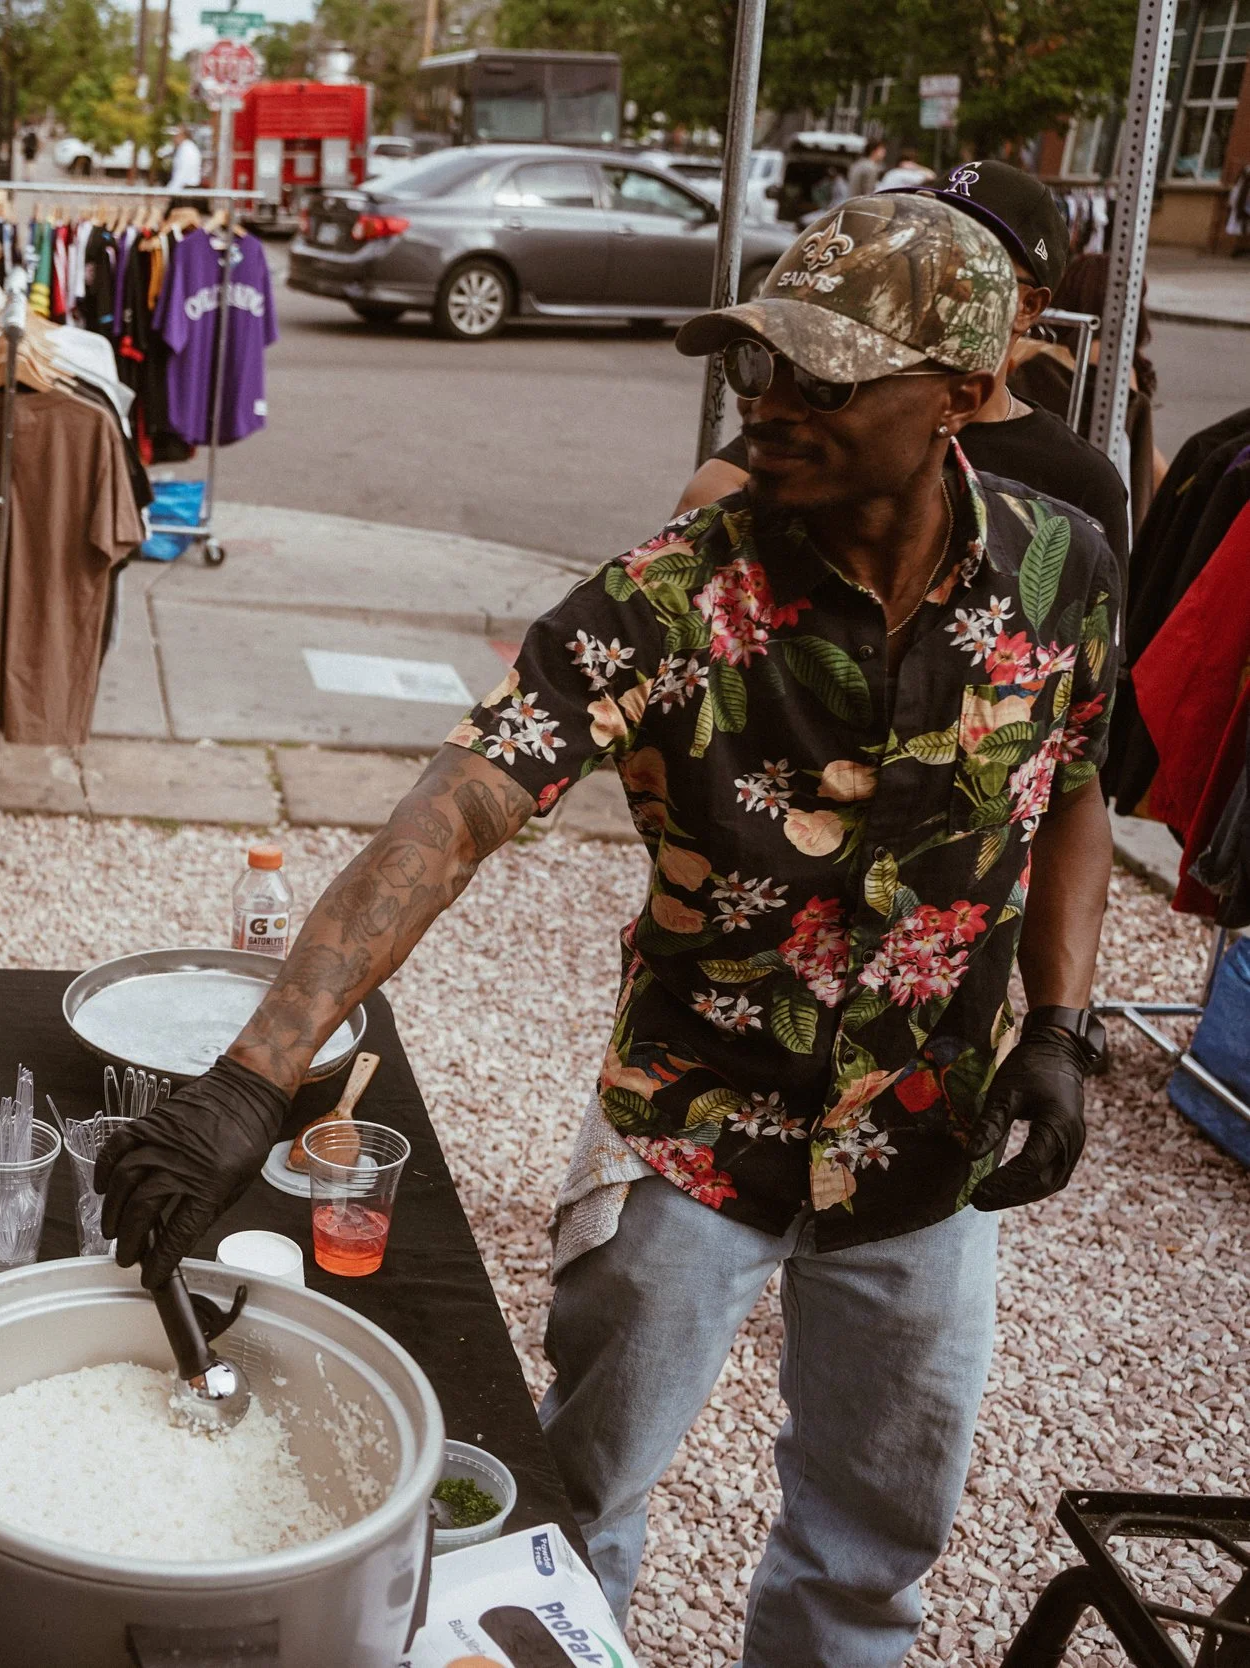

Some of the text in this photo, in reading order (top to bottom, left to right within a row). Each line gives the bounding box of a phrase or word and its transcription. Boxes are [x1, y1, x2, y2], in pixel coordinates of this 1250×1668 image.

[777, 271, 836, 293] SAINTS
[250, 917, 268, 936] G
[534, 1545, 543, 1566] Free
[540, 1538, 553, 1569] Powder
